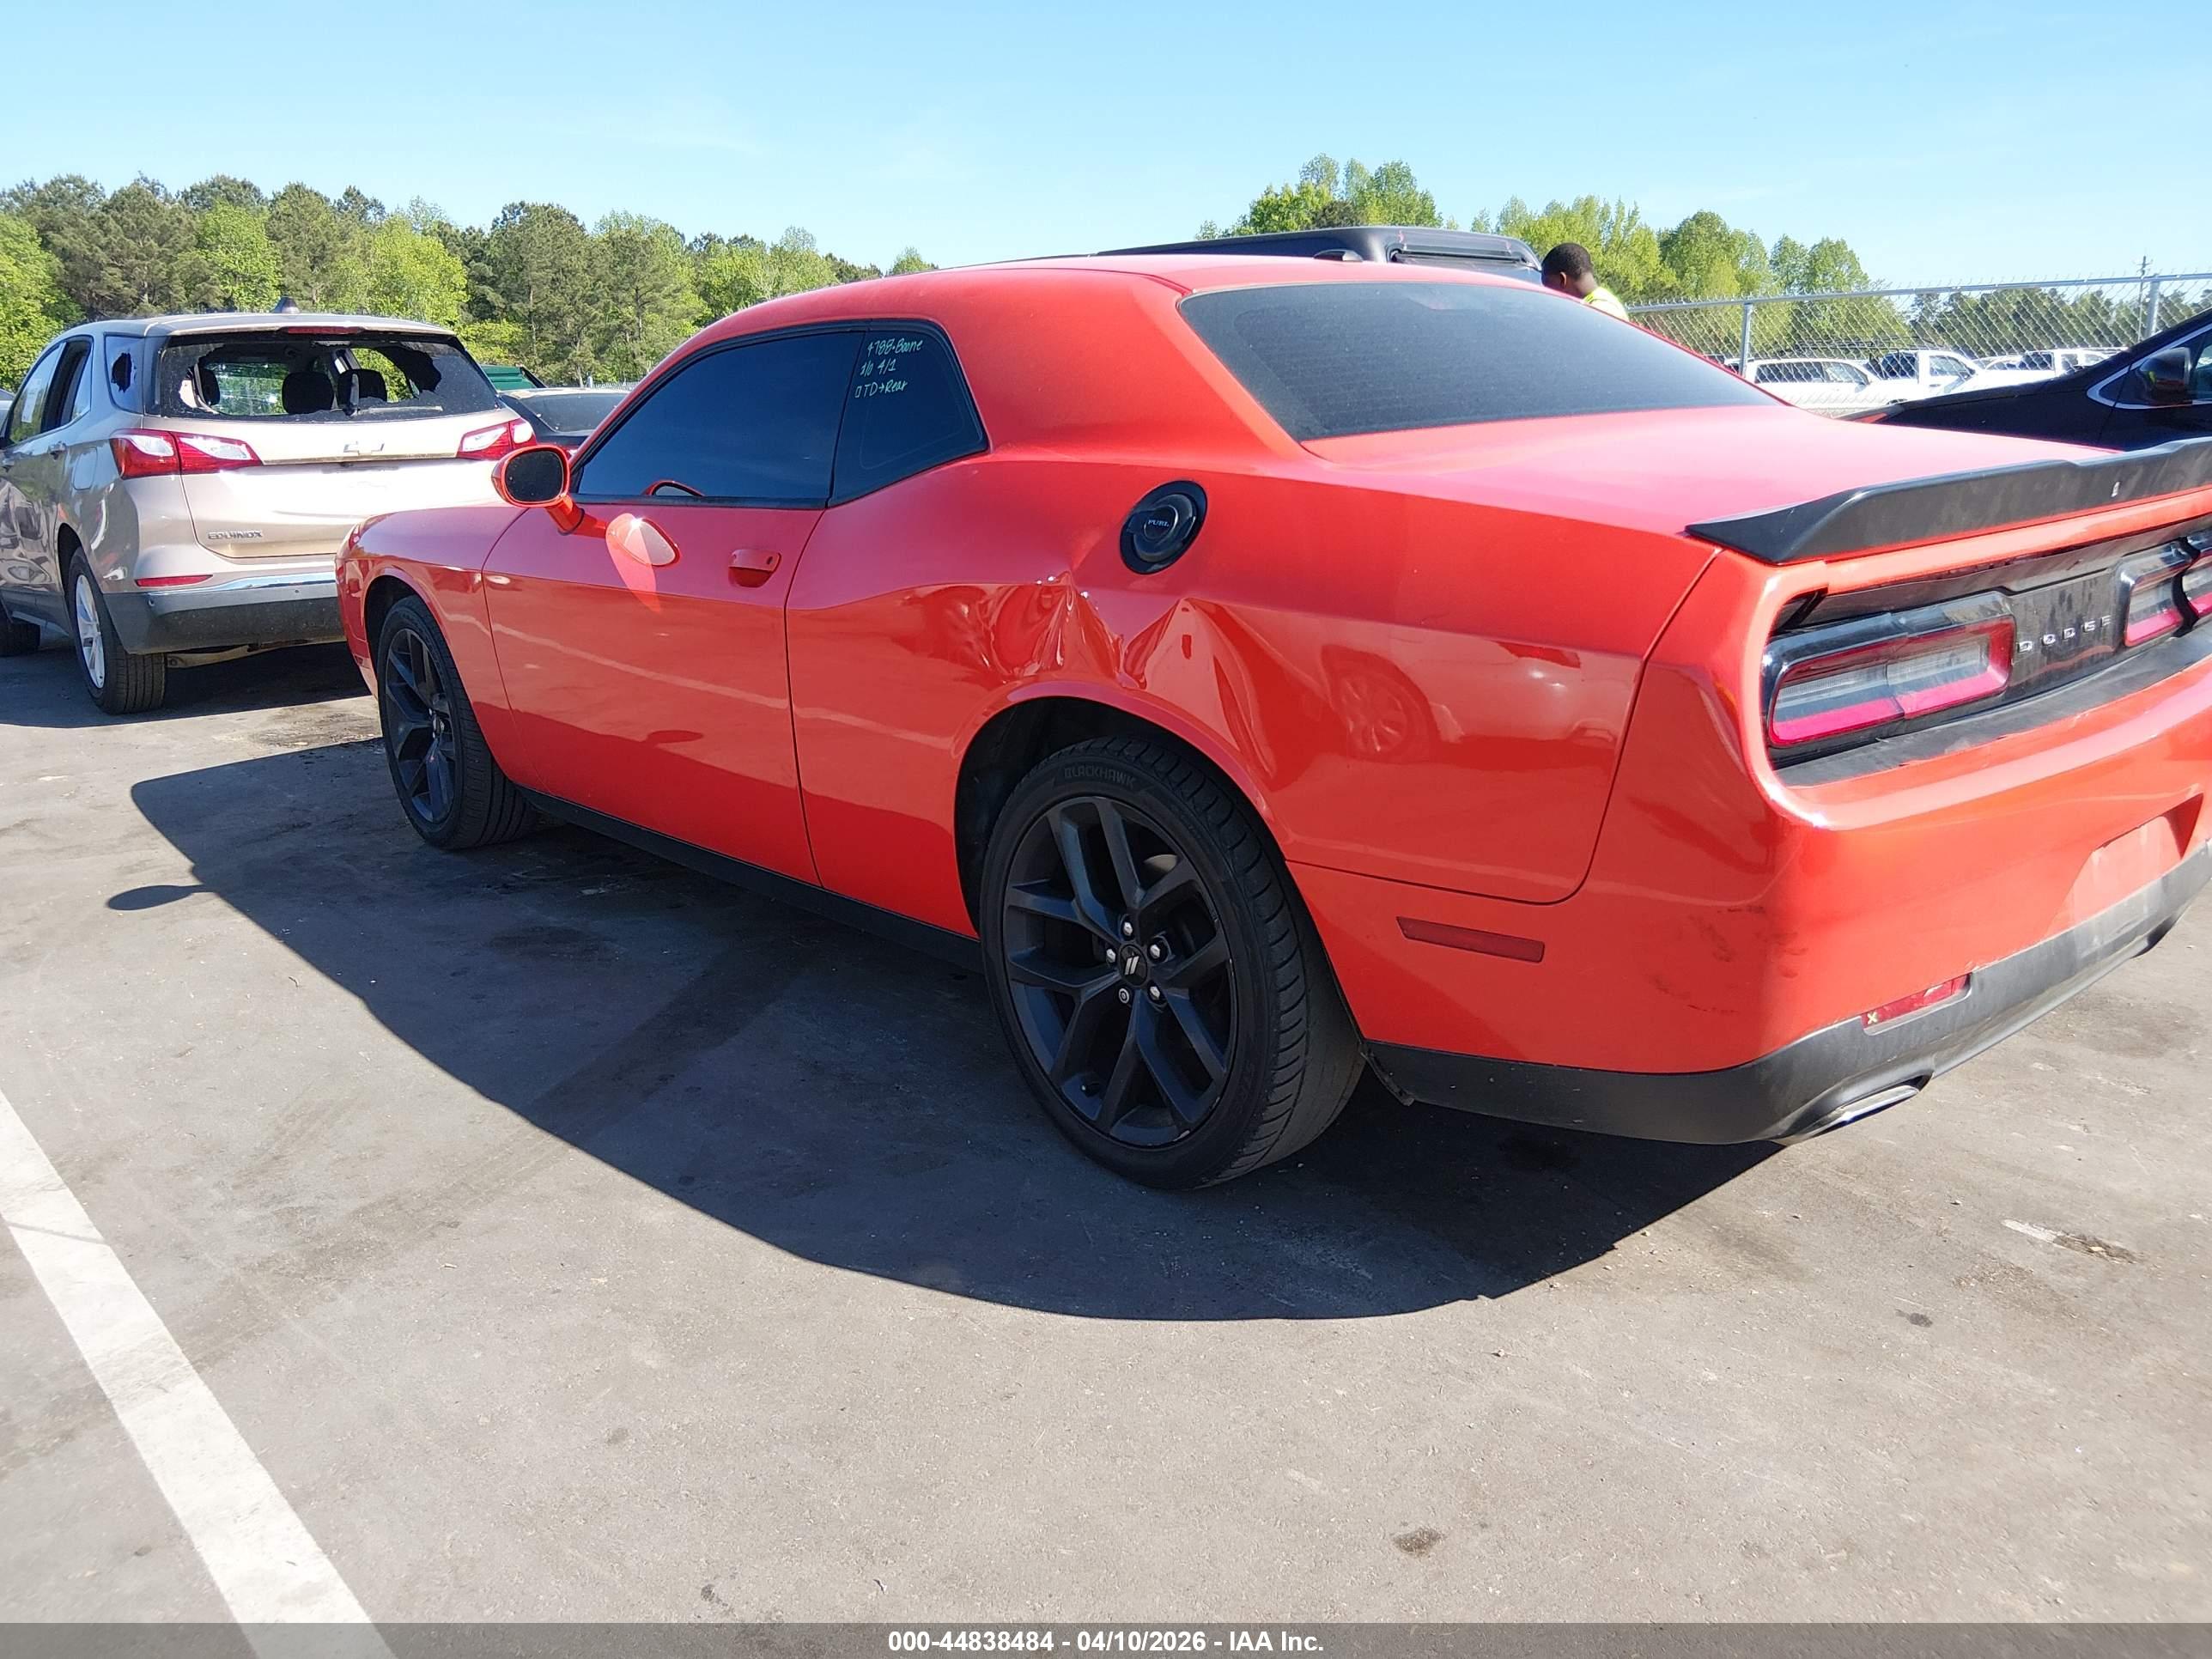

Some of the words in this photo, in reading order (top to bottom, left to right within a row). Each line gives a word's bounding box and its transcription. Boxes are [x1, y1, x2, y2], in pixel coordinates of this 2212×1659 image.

[208, 530, 263, 540] EQUINOX
[2017, 615, 2112, 653] DODGE
[1064, 763, 1136, 789] BLACKHAWK
